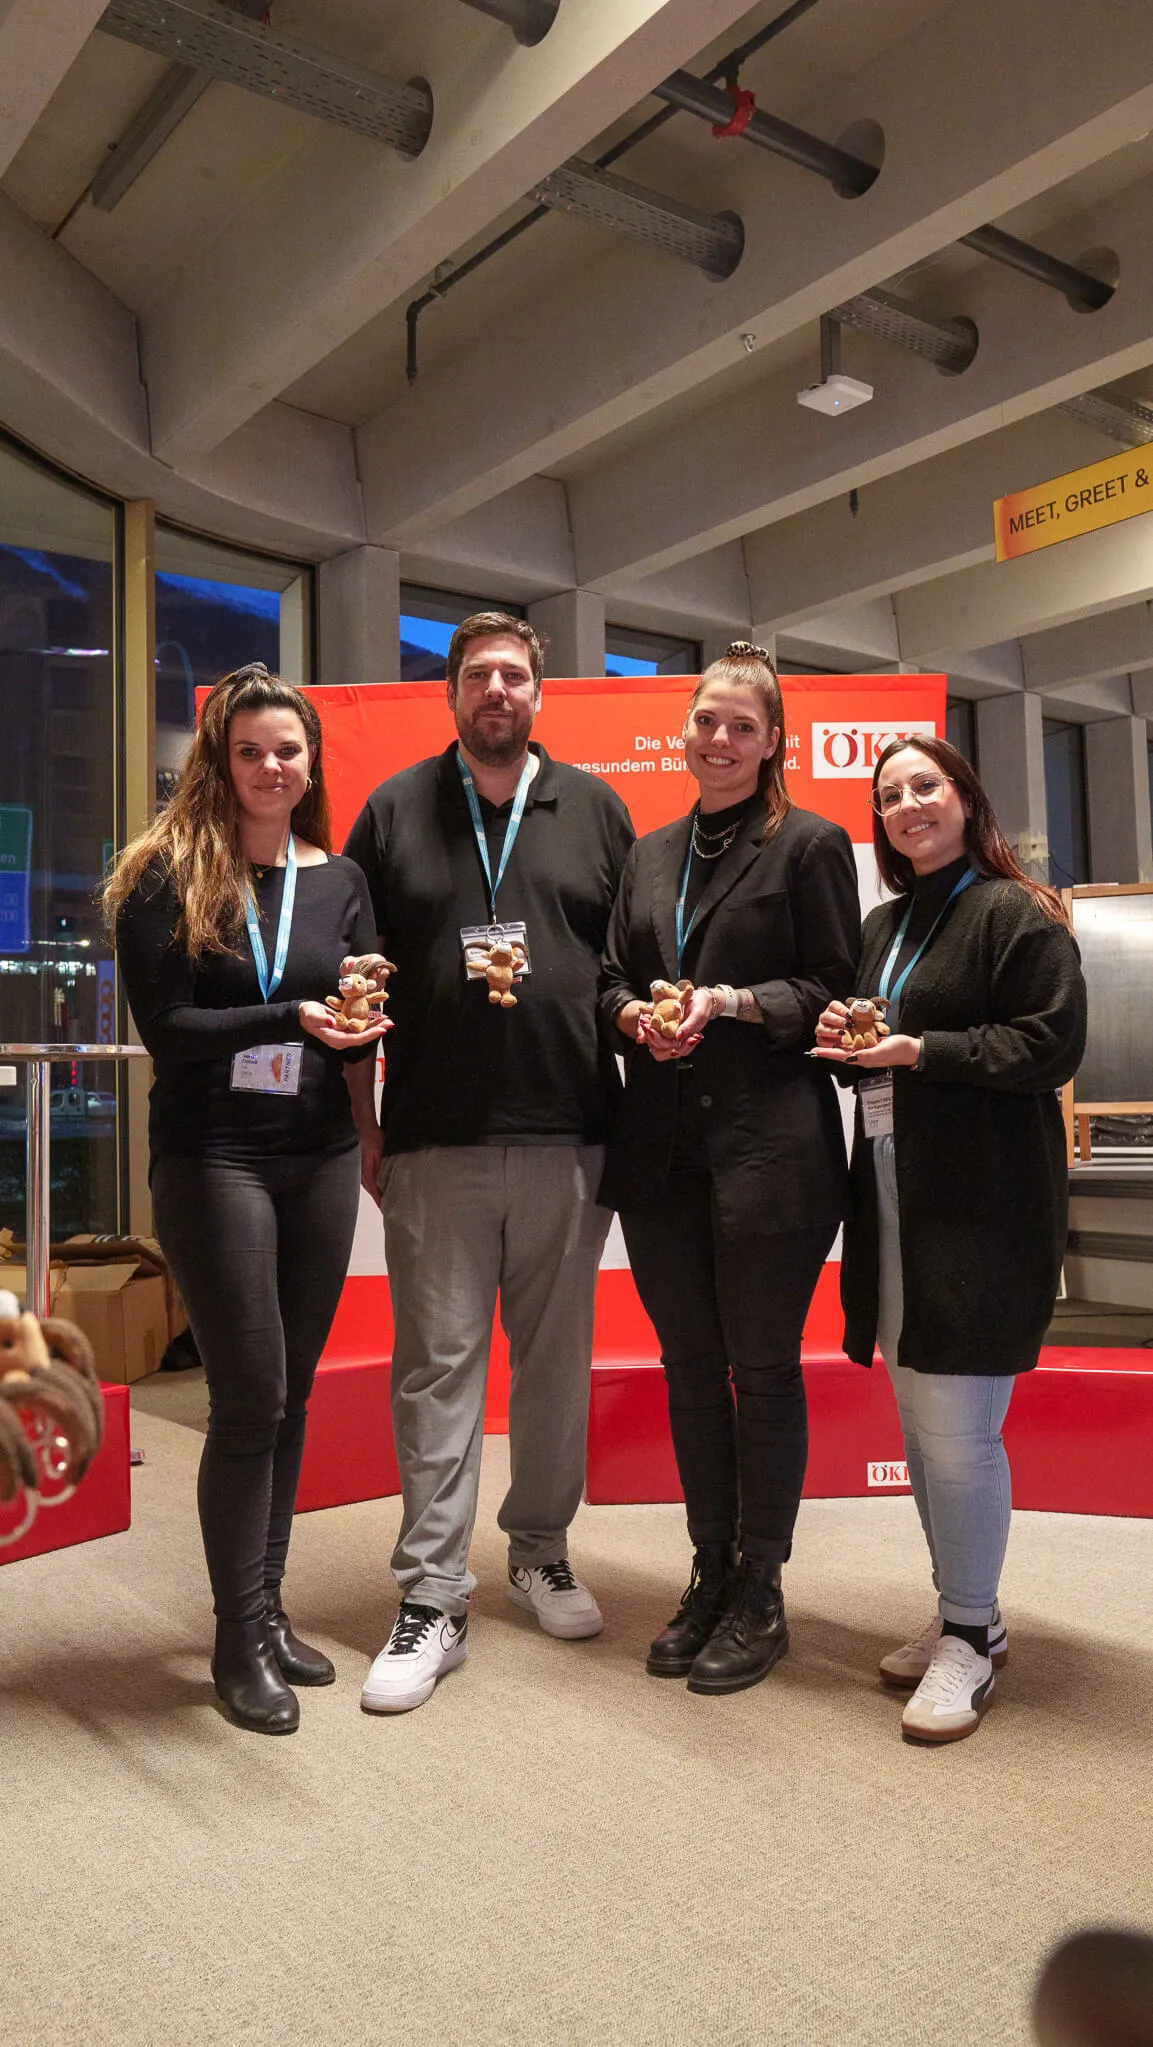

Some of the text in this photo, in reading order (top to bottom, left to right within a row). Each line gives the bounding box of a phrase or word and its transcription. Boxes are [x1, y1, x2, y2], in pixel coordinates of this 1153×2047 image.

[1009, 468, 1149, 535] MEET, GREET &
[634, 736, 661, 751] Die
[822, 729, 924, 768] ÖK
[283, 1052, 292, 1083] PARTNER
